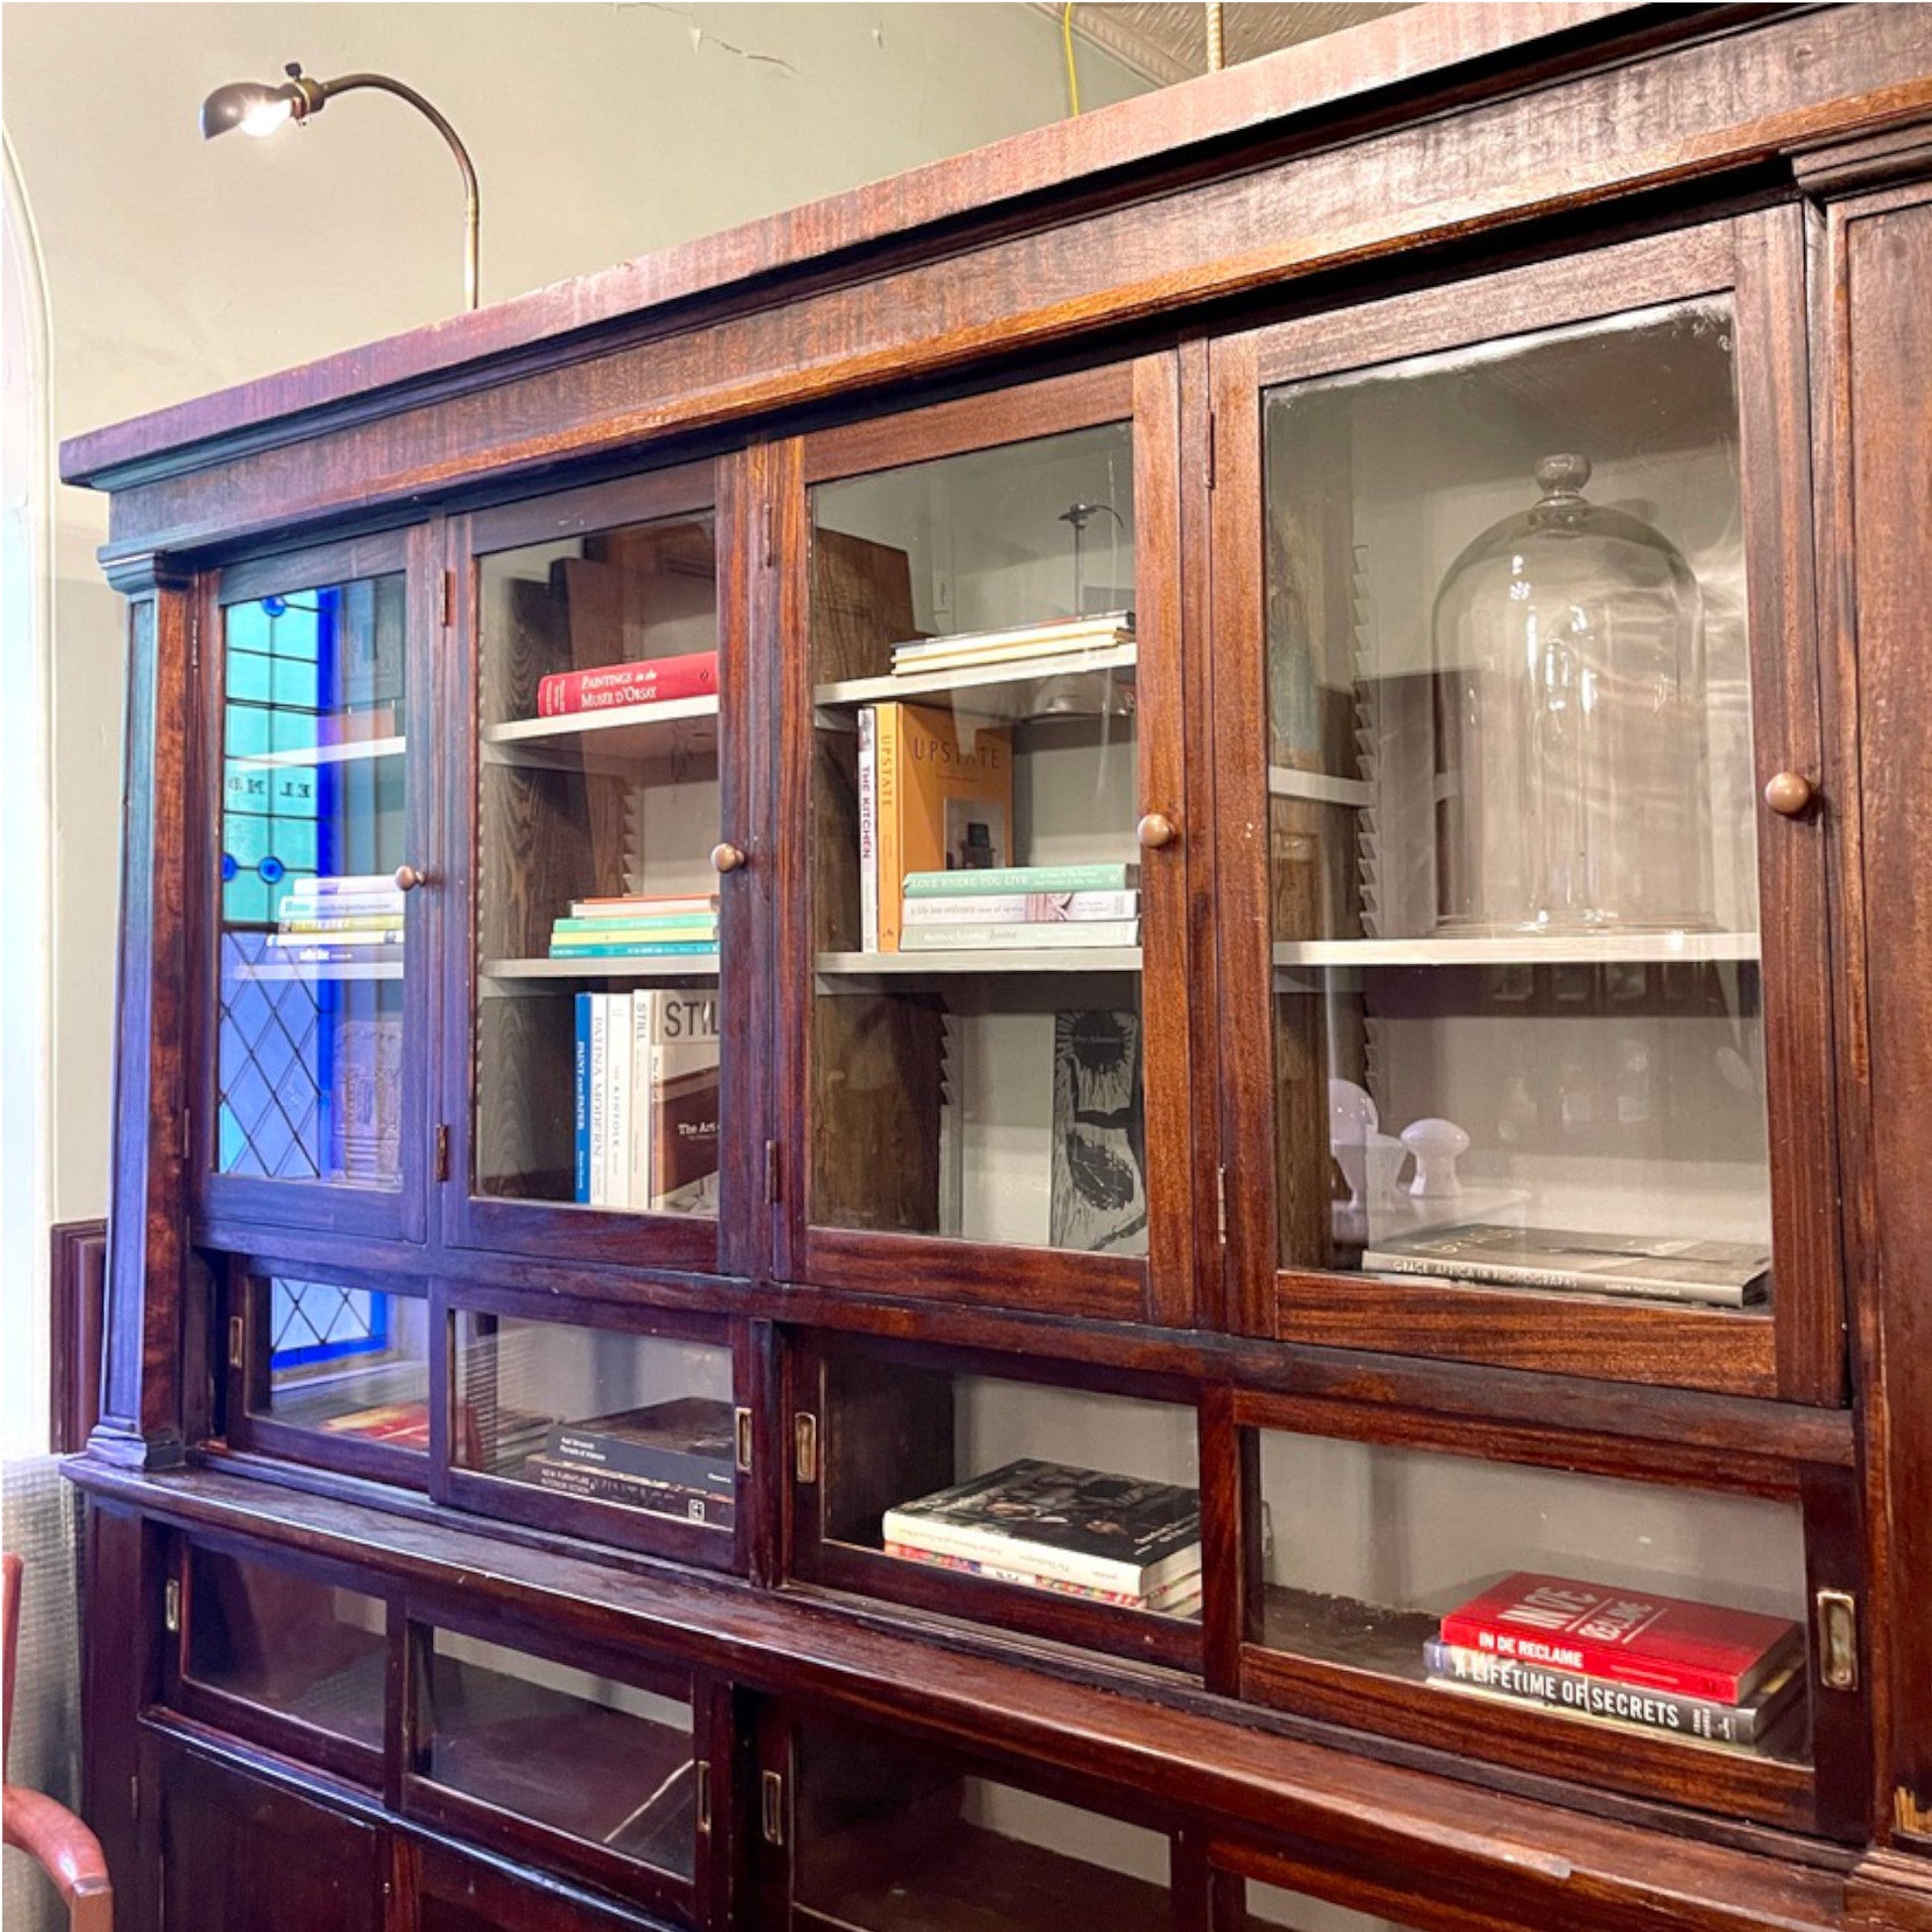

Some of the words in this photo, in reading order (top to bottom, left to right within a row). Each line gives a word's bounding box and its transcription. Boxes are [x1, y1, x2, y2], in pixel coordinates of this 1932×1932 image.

[862, 765, 872, 791] THE
[881, 734, 893, 806] UPSTATE
[862, 797, 872, 860] KITCHEN
[911, 878, 937, 889] LOVE
[980, 875, 1002, 887] YOU
[1004, 874, 1029, 886] LIVE
[635, 1002, 647, 1041] STILL
[594, 1017, 603, 1076] PATINA
[593, 1083, 603, 1158] MODERN
[678, 1123, 698, 1135] The
[699, 1121, 717, 1133] Art
[1478, 1631, 1494, 1649] IN
[1496, 1635, 1516, 1654] DE
[1518, 1640, 1585, 1669] RECLAME
[1471, 1656, 1557, 1700] LIFETIME
[1562, 1680, 1587, 1707] OF
[1590, 1687, 1680, 1727] SECRETS
